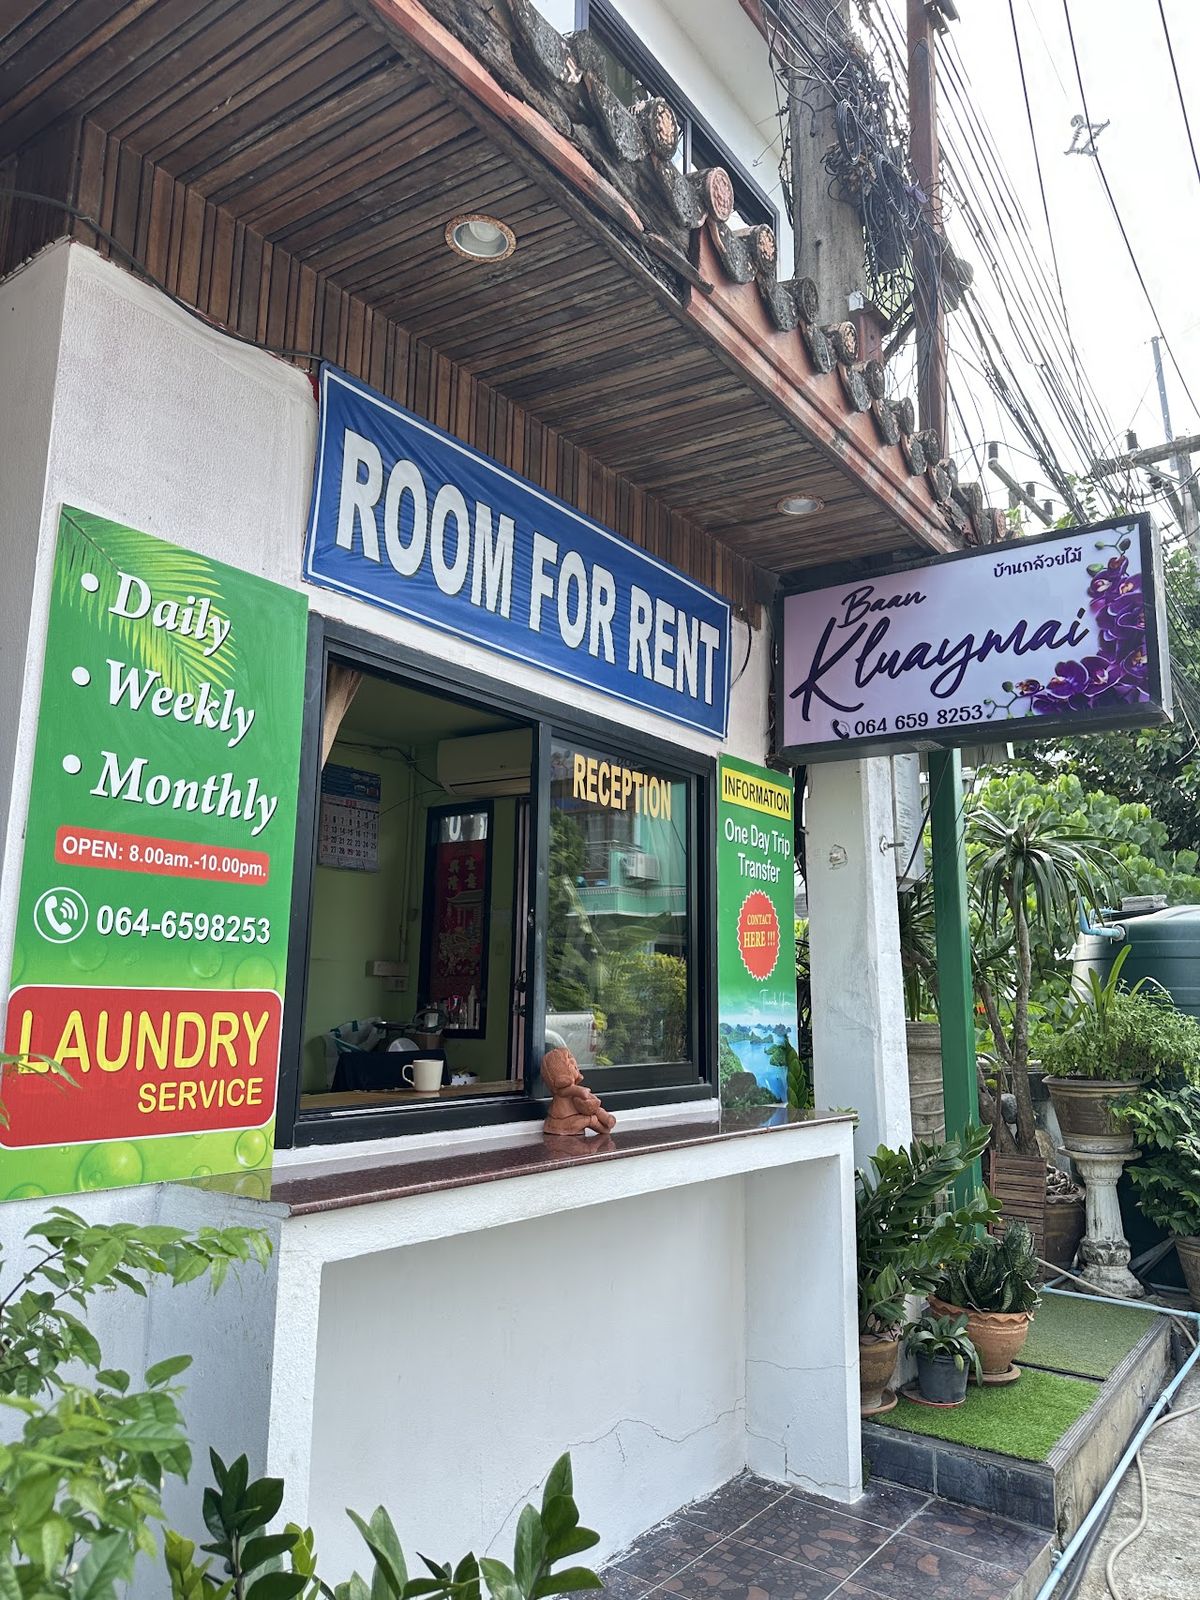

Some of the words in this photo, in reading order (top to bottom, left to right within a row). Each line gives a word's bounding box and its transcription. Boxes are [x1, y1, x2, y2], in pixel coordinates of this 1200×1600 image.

[336, 427, 515, 619] ROOM
[529, 531, 616, 665] FOR
[628, 584, 720, 705] RENT
[994, 547, 1082, 578] บ้านกล้วยไม้
[108, 571, 231, 656] Daily
[837, 585, 927, 629] Baan
[789, 607, 1089, 722] Kluaymai
[106, 658, 255, 748] Weekly
[854, 717, 887, 736] 064
[895, 712, 929, 730] 659
[937, 704, 983, 725] 8253
[90, 750, 278, 836] Monthly
[573, 752, 672, 821] RECEPTION
[725, 774, 789, 814] INFORMATION
[62, 835, 123, 860] OPEN:
[725, 817, 748, 846] One
[751, 824, 770, 856] Day
[772, 830, 790, 860] Trip
[738, 852, 780, 883] Transfer
[96, 904, 271, 945] 064-6598253
[743, 931, 766, 948] HERE
[747, 914, 772, 926] CONTACT
[18, 1010, 270, 1075] LAUNDRY
[137, 1077, 263, 1113] SERVICE
